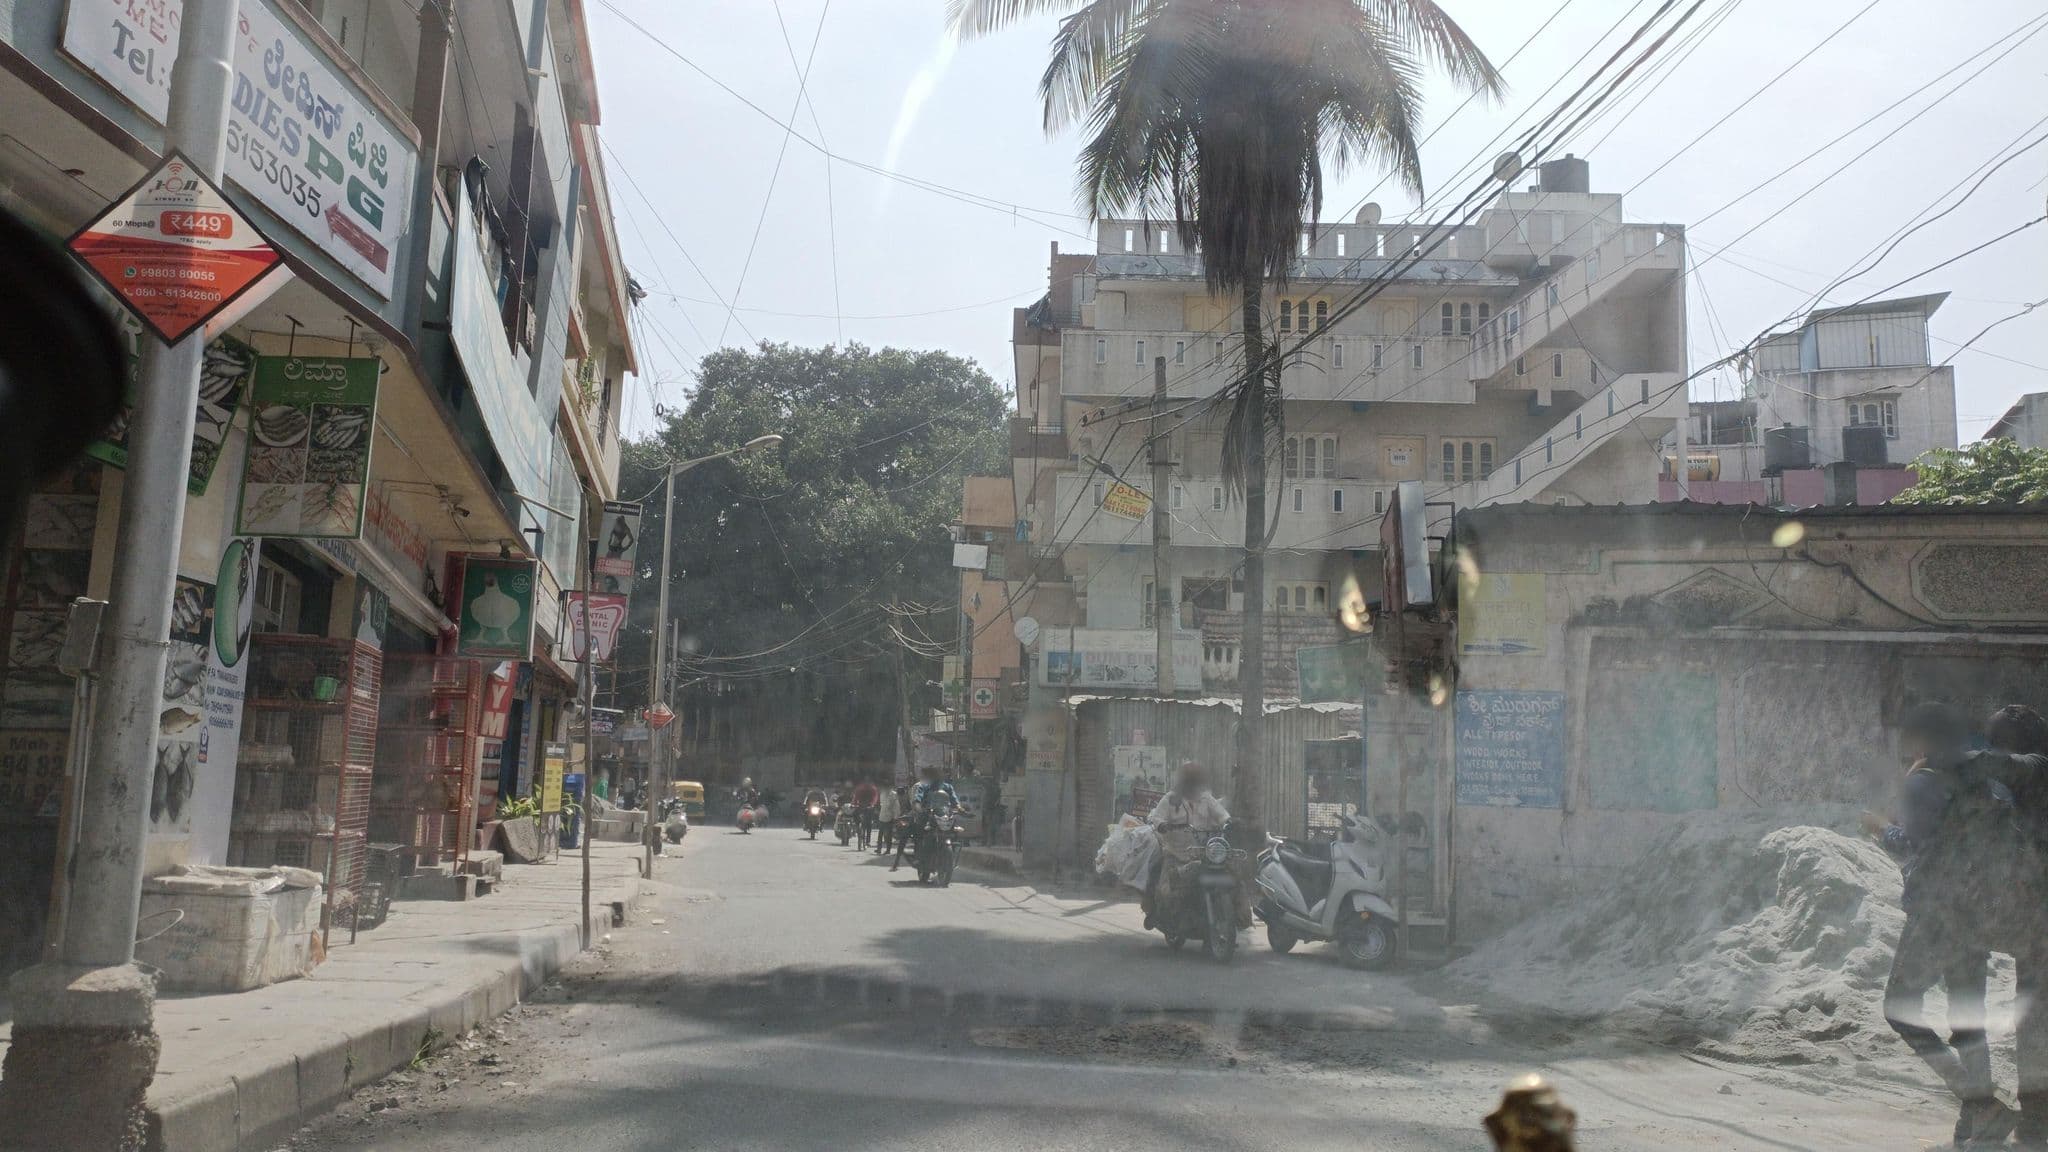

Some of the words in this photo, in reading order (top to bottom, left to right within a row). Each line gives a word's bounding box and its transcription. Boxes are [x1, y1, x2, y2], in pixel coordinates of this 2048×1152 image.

[141, 268, 176, 278] 99803
[179, 269, 216, 281] 80055
[576, 620, 608, 628] CNIC
